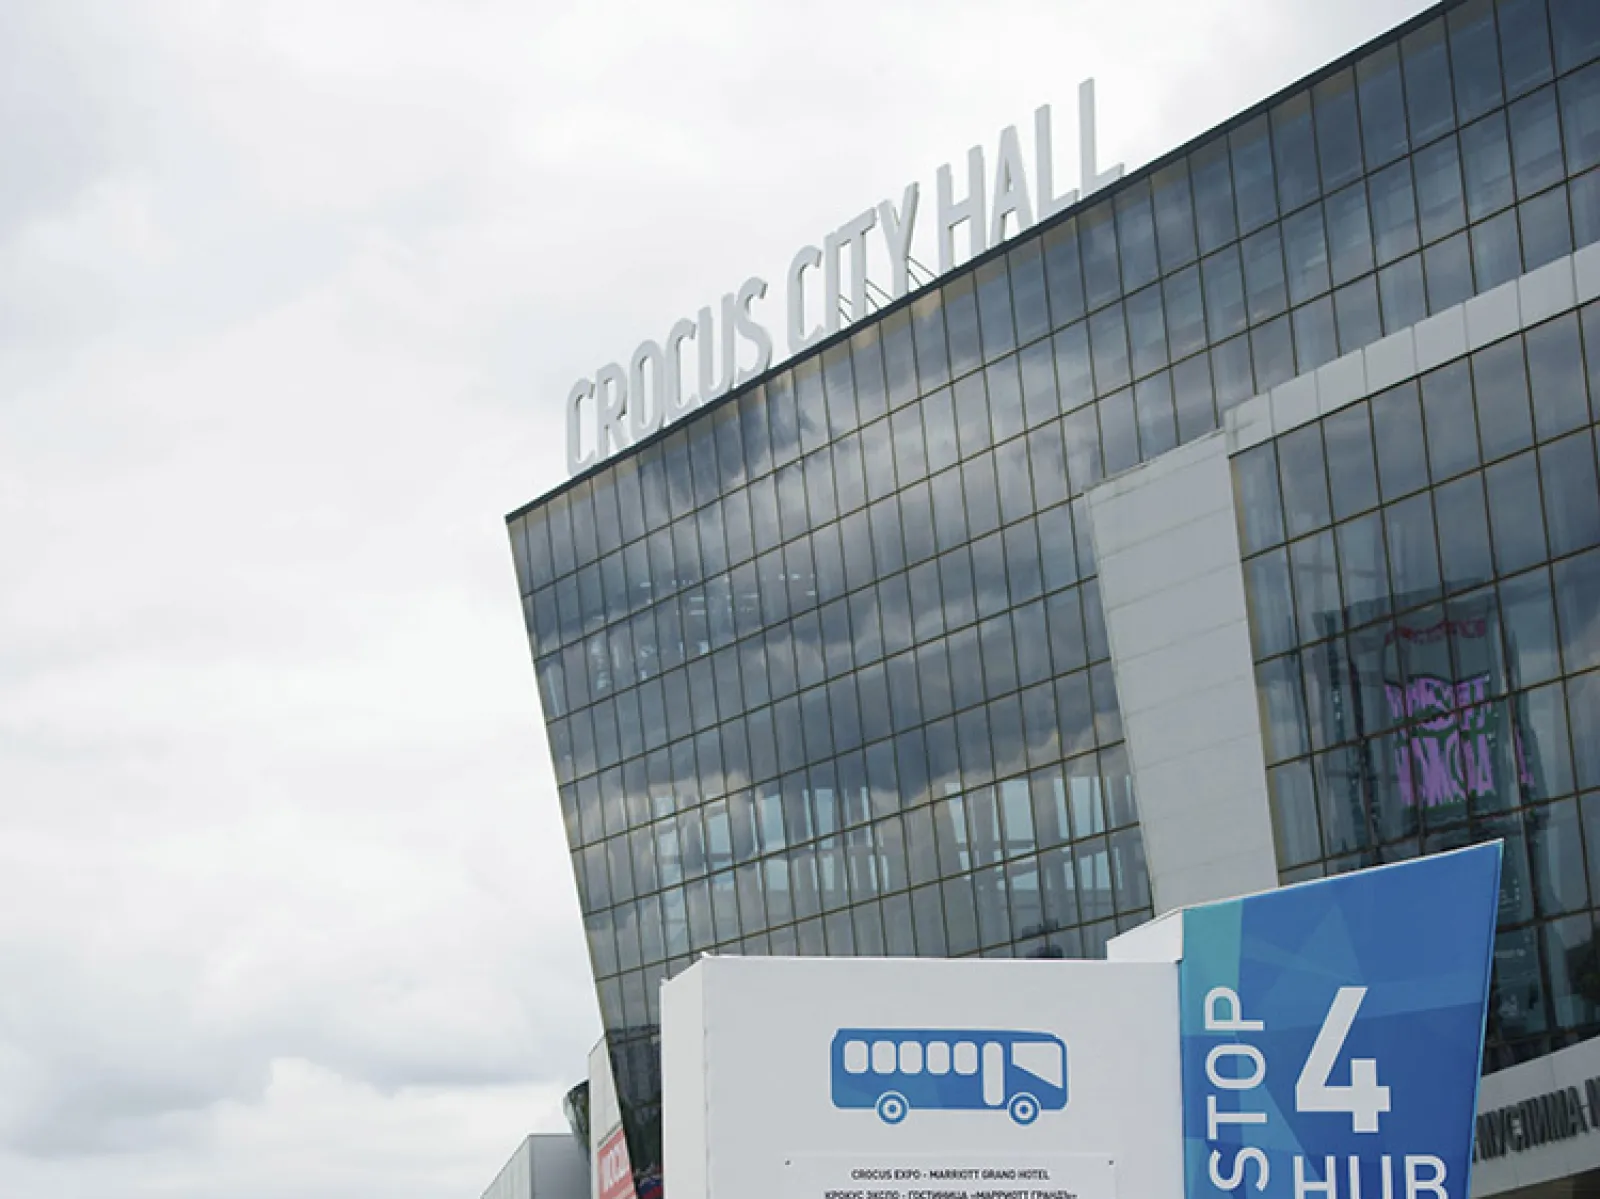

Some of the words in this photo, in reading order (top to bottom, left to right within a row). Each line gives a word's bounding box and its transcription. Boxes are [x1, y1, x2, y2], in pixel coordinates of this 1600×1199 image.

[565, 277, 772, 477] CROCUS
[787, 181, 920, 354] CITY
[936, 77, 1124, 272] HALL
[1204, 986, 1271, 1192] STOP
[1295, 986, 1391, 1133] 4
[851, 1168, 892, 1180] CROCUS
[894, 1168, 921, 1180] EXPO
[930, 1168, 979, 1180] MARRIOTT
[981, 1168, 1016, 1180] GRAND
[1018, 1168, 1050, 1180] HOTEL
